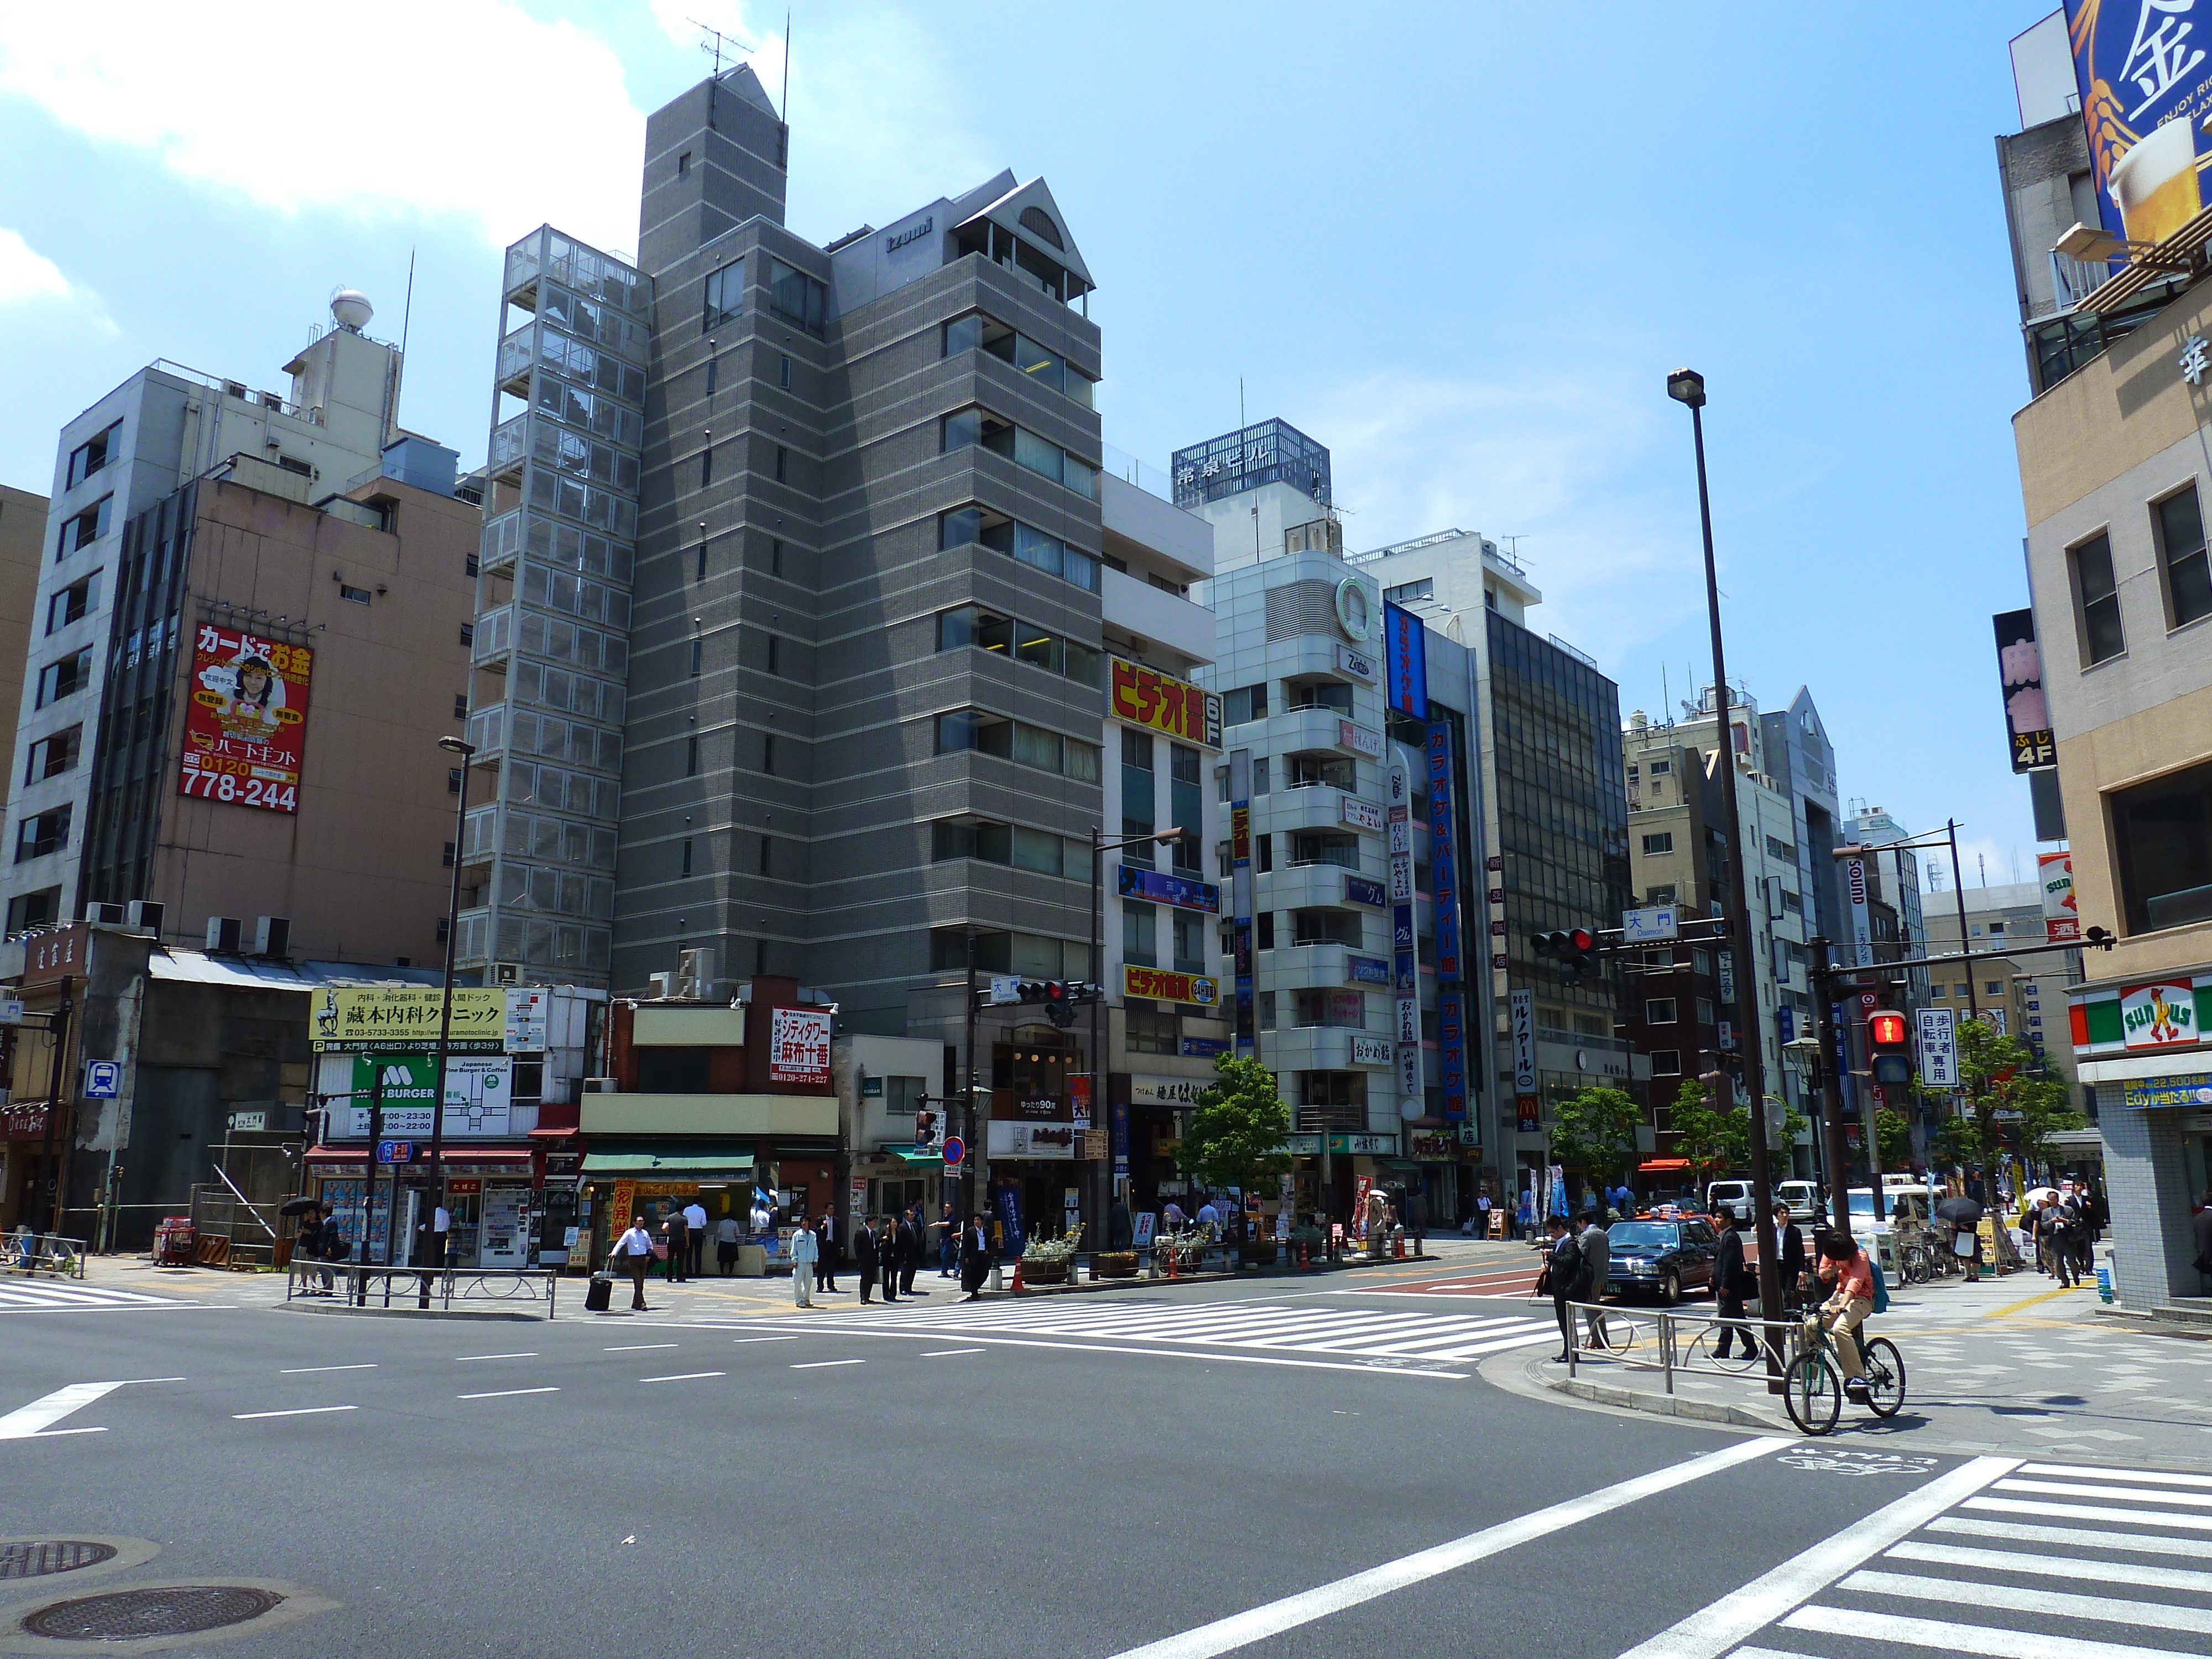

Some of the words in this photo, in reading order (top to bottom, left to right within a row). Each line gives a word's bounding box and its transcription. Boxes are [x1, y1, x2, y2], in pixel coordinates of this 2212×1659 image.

[2119, 0, 2205, 122] 金
[2157, 92, 2193, 128] ENJOY
[886, 216, 932, 253] izumi
[1177, 445, 1271, 484] 常泉ビル
[198, 625, 311, 675] カードでお金
[1349, 654, 1369, 675] ZERO
[1399, 614, 1412, 714] カラオケ館
[204, 674, 234, 686] 欢迎中文
[1113, 661, 1203, 742] ビデオ鑑賞
[1206, 697, 1219, 743] 6F
[215, 739, 296, 765] ハートギフト
[2015, 732, 2049, 747] ふじ
[201, 755, 249, 776] 0120
[2017, 745, 2052, 764] 4F
[183, 767, 296, 811] 778-244
[1359, 813, 1381, 828] やよい
[1629, 913, 1671, 929] 大門
[994, 980, 1018, 993] 大門
[1127, 969, 1190, 1000] ビデオ鑑賞
[782, 1019, 828, 1041] シティタワー
[1515, 1006, 1532, 1072] ルノアール
[1923, 1015, 1937, 1053] 自転車
[1936, 1015, 1951, 1053] 歩行者
[781, 1040, 828, 1065] 麻布十番
[1355, 1044, 1390, 1061] おかめ鮨
[1444, 1001, 1463, 1112] カラオケ館
[779, 1073, 827, 1084] 0120-274-227
[1932, 1055, 1945, 1080] 専用
[387, 1088, 435, 1098] BURGER
[384, 1144, 392, 1157] 15
[614, 1191, 629, 1237] お弁当
